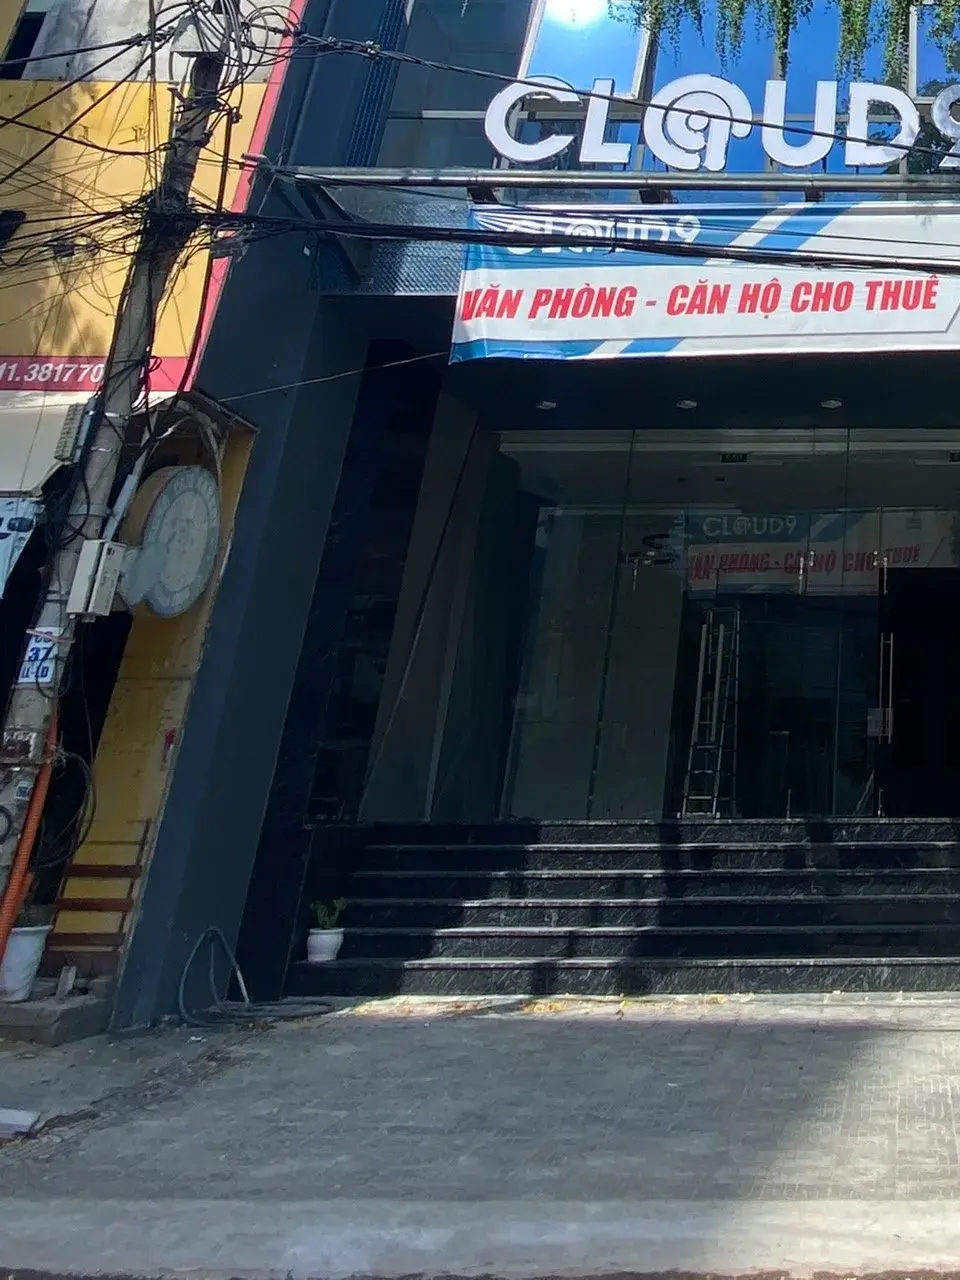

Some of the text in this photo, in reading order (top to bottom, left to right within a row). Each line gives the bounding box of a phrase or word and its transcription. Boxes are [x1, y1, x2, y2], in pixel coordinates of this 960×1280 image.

[461, 283, 523, 322] VĂN
[528, 281, 636, 319] PHÒNG
[666, 279, 728, 316] CĂN
[738, 277, 782, 319] HỘ
[790, 282, 856, 313] CHO
[865, 274, 938, 311] THUÊ
[28, 646, 54, 662] 37
